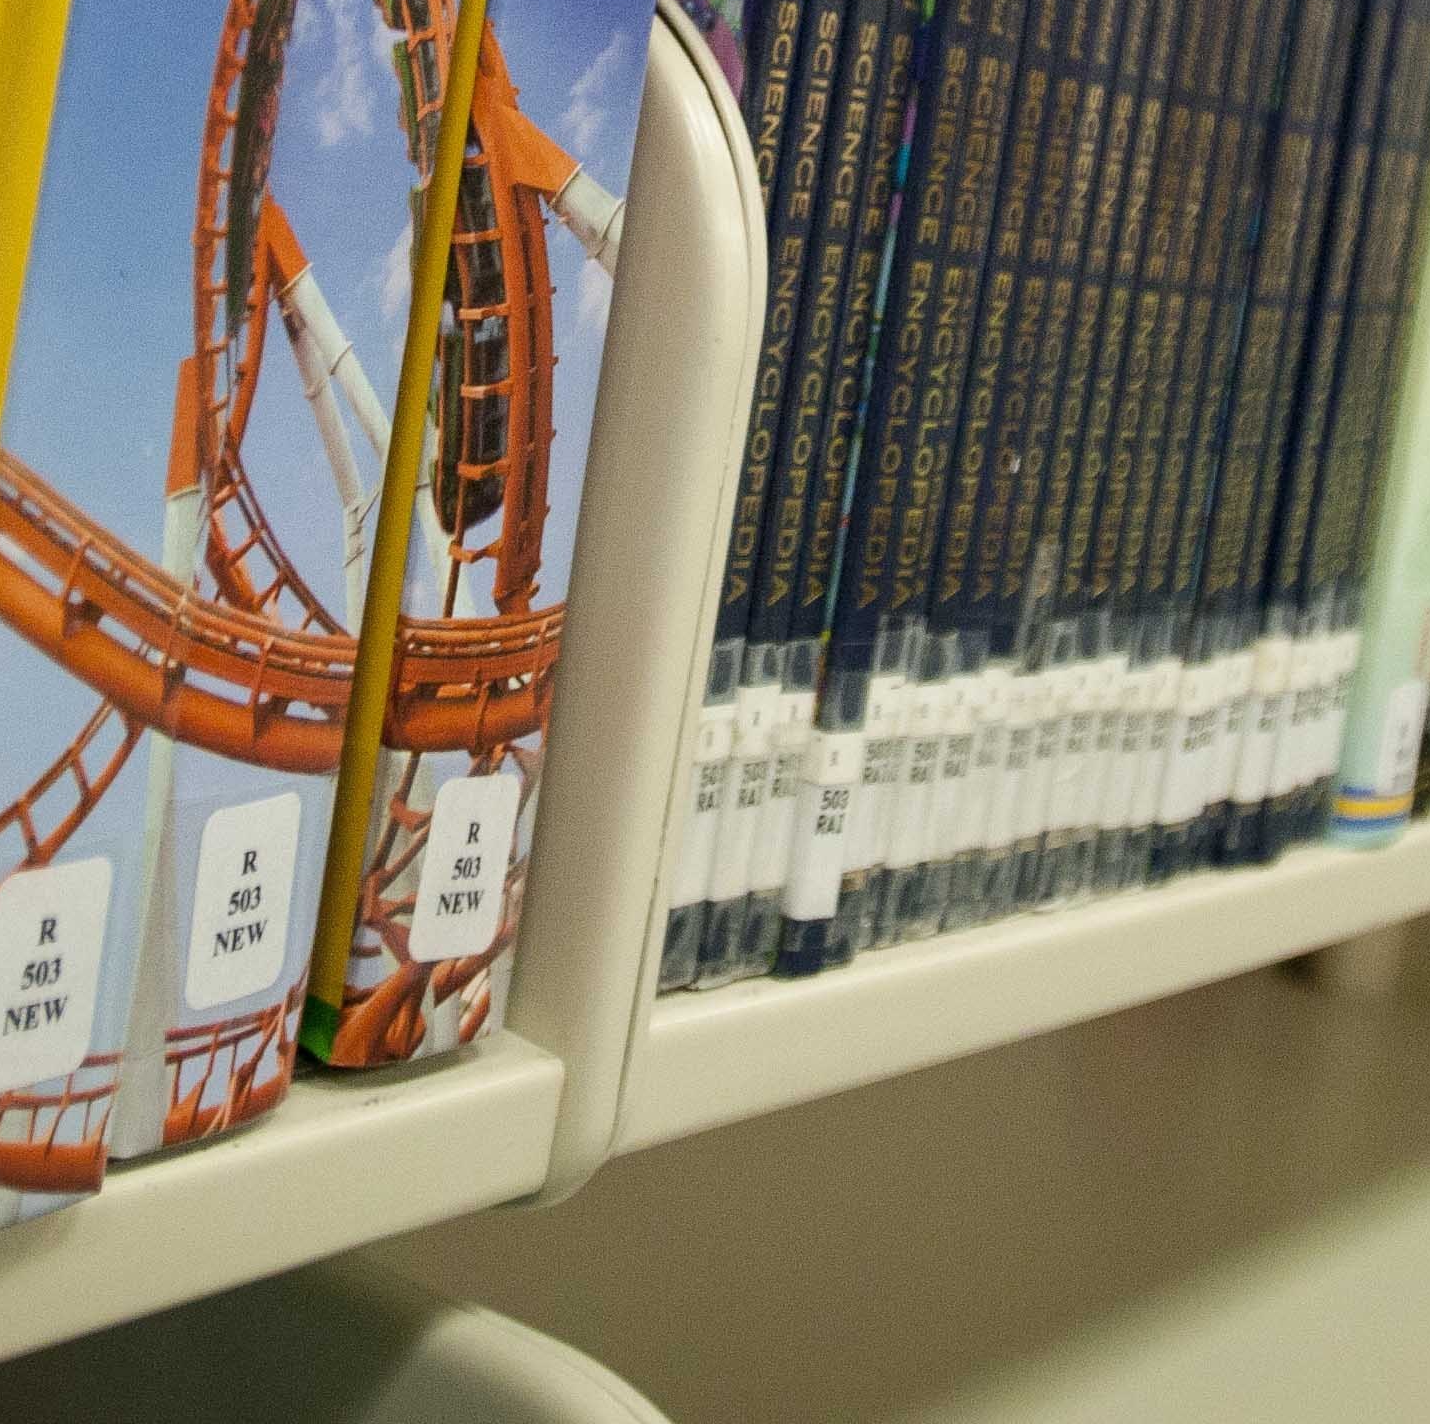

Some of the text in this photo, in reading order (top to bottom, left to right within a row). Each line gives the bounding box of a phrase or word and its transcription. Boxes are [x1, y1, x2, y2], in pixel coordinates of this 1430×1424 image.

[790, 10, 839, 219] SCIENCE
[827, 22, 880, 231] SCIENCE
[916, 47, 968, 244] SCIENCE
[948, 56, 999, 251] SCIENCE
[725, 236, 803, 604] ENCYCLOPEDIA
[765, 244, 844, 606] ENCYCLOPEDIA
[856, 261, 932, 608] ENCYCLOPEDIA
[890, 267, 964, 608] ENCYCLOPEDIA
[820, 789, 851, 810] 503
[466, 820, 481, 847] R
[815, 814, 846, 835] RAI
[241, 849, 260, 878] R
[451, 855, 484, 883] 503
[225, 885, 263, 917] 503
[433, 887, 485, 919] NEW
[38, 915, 58, 948] R
[211, 919, 270, 958] NEW
[19, 958, 64, 993] 503
[0, 996, 71, 1038] NEW
